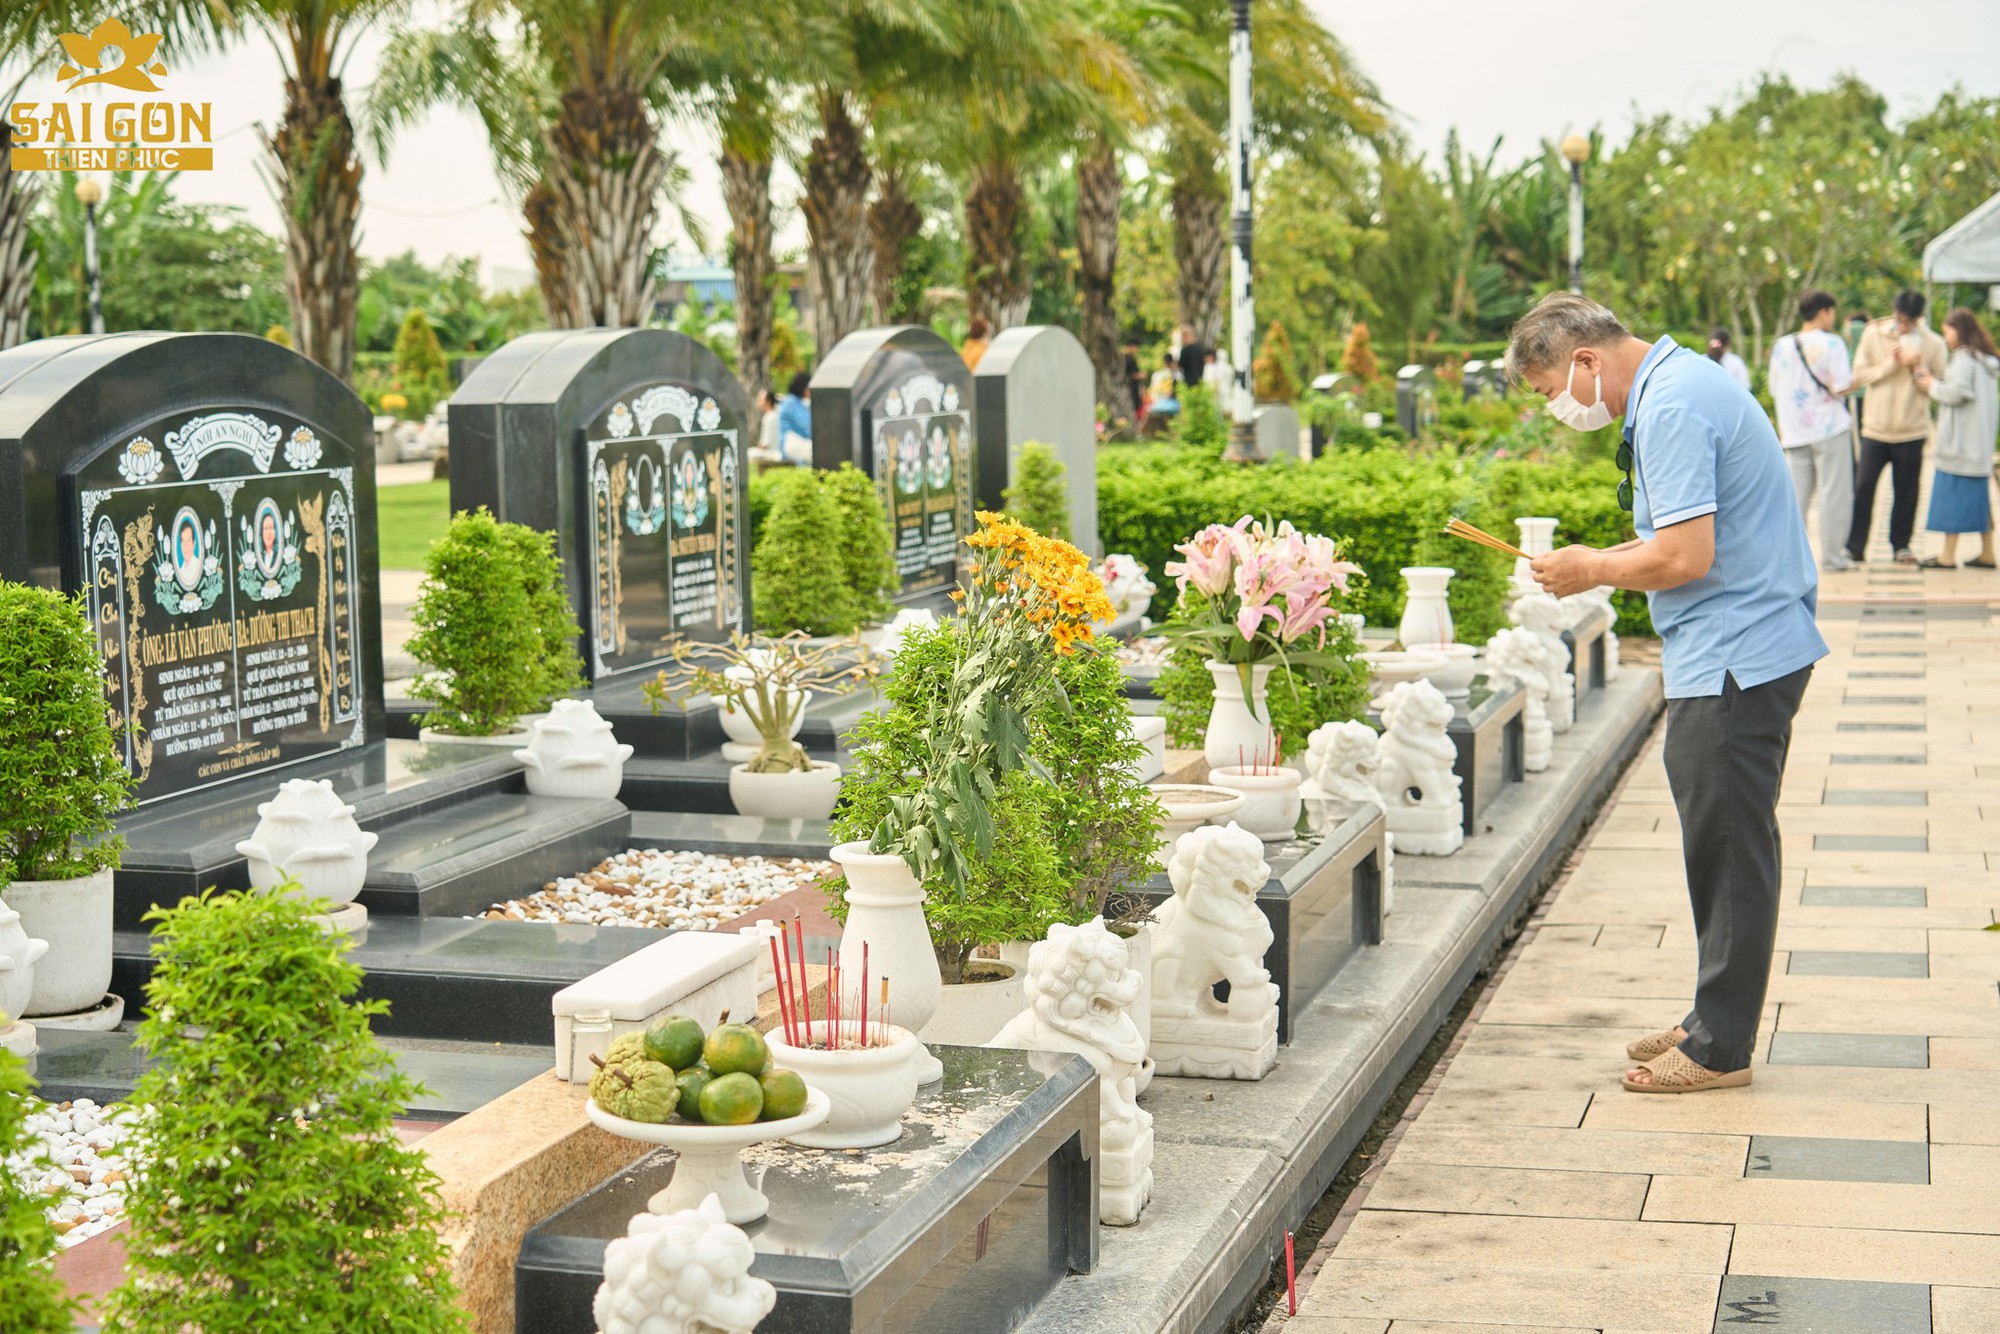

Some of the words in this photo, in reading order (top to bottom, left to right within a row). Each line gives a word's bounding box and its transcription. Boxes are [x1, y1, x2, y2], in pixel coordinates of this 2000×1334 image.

[216, 424, 228, 440] AN
[165, 624, 177, 662] LÊ
[178, 622, 196, 660] VĂN
